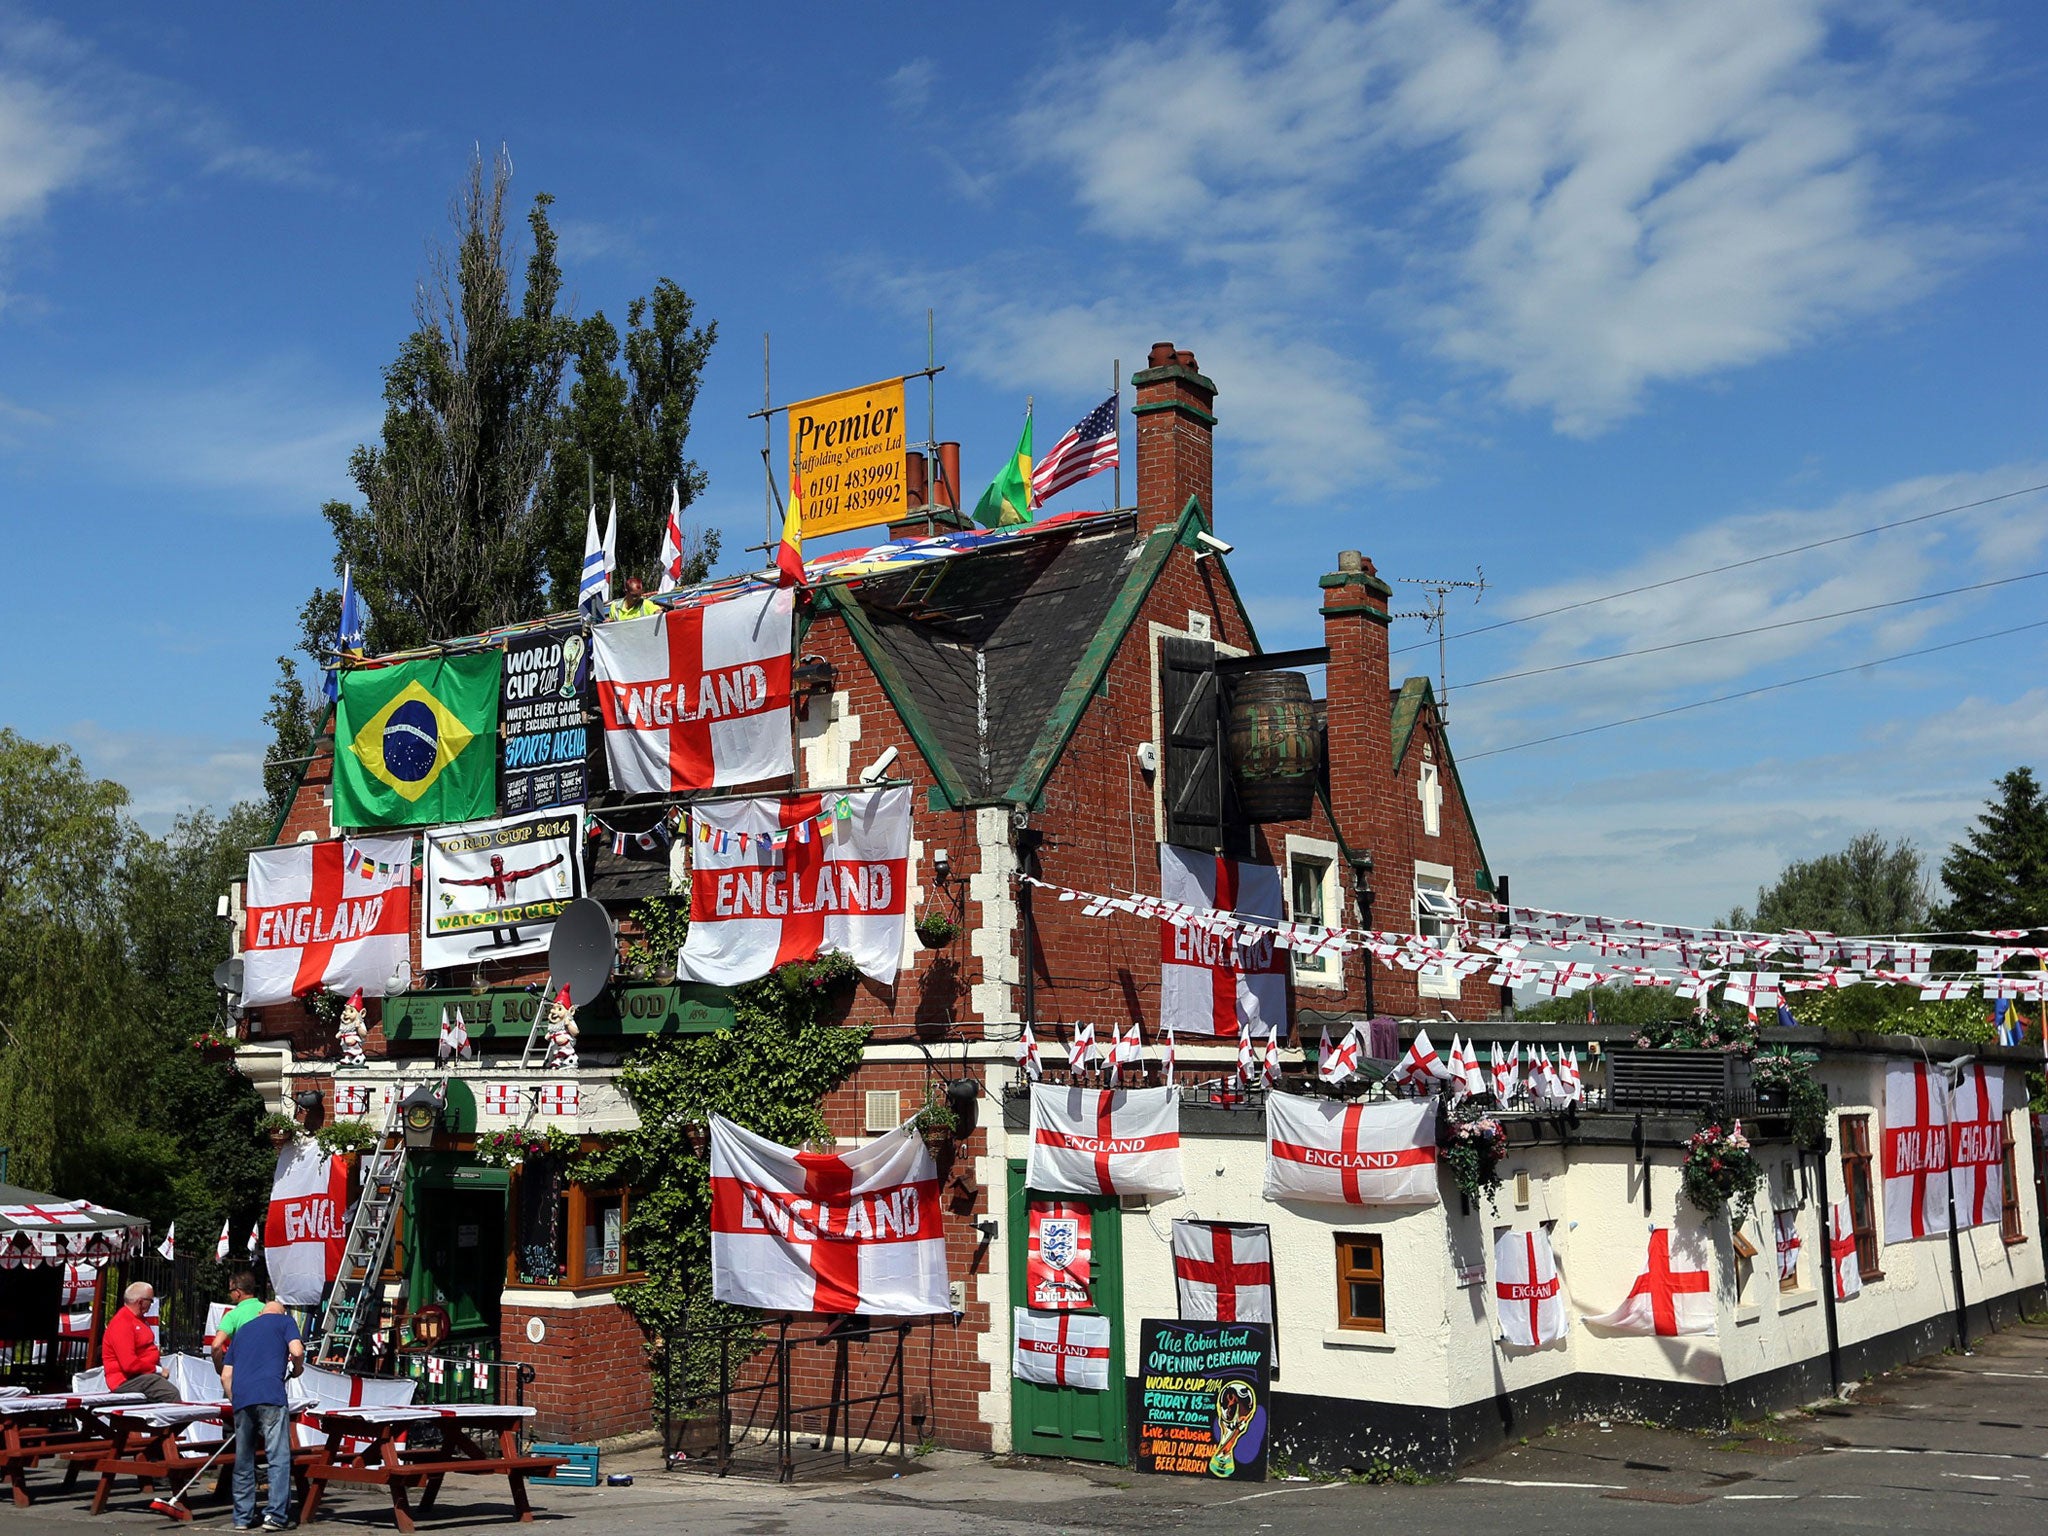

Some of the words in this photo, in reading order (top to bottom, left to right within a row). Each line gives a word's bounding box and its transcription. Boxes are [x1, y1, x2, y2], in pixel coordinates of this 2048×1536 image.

[798, 401, 898, 453] Premier
[792, 451, 842, 473] Saffolding
[845, 441, 883, 463] Services
[885, 435, 902, 451] Ltd
[810, 474, 840, 497] 0191
[844, 461, 900, 490] 4839991
[809, 495, 839, 520] 0191
[844, 483, 901, 512] 4839992
[507, 644, 561, 674] WORLD
[506, 672, 538, 700] CUP
[539, 667, 559, 696] 2014
[614, 664, 767, 727] ENGLAND
[506, 705, 532, 721] WATCH
[534, 701, 558, 717] EVERY
[557, 699, 580, 714] GAME
[507, 721, 521, 735] LIVE
[525, 716, 559, 732] EXCLUSIVE
[559, 715, 568, 727] IN
[568, 712, 582, 725] OUR
[506, 731, 551, 767] SPORTS
[552, 727, 587, 760] ARENA
[496, 826, 532, 845] CUP
[537, 821, 571, 838] 2014
[716, 865, 892, 916] ENGLAND
[256, 896, 384, 947] ENGLAND
[437, 910, 497, 930] WATCH
[502, 907, 522, 923] IT
[525, 900, 573, 919] HER
[445, 1000, 492, 1024] THE
[1064, 1135, 1146, 1153] ENGLAND
[1305, 1150, 1399, 1168] ENGLAND
[742, 1186, 920, 1242] ENGLAND
[1035, 1290, 1087, 1302] ENGLAND
[1034, 1341, 1088, 1358] ENGLAND
[1156, 1330, 1182, 1353] The
[1184, 1332, 1218, 1353] Robin
[1220, 1330, 1249, 1350] Hood
[1149, 1350, 1205, 1373] OPENING
[1206, 1350, 1261, 1370] CEREMONY
[1145, 1375, 1183, 1390] WORLD
[1184, 1378, 1206, 1391] CUP
[1205, 1378, 1222, 1393] 2014
[1143, 1392, 1188, 1409] FRIDAY
[1148, 1408, 1175, 1421] FROM
[1142, 1424, 1163, 1438] Live
[1170, 1427, 1212, 1442] exclusive
[1151, 1439, 1177, 1456] WORLD
[1177, 1441, 1194, 1457] CUP
[1193, 1443, 1218, 1459] ARENA
[1155, 1456, 1176, 1472] BEER
[1176, 1458, 1208, 1473] GARDEN
